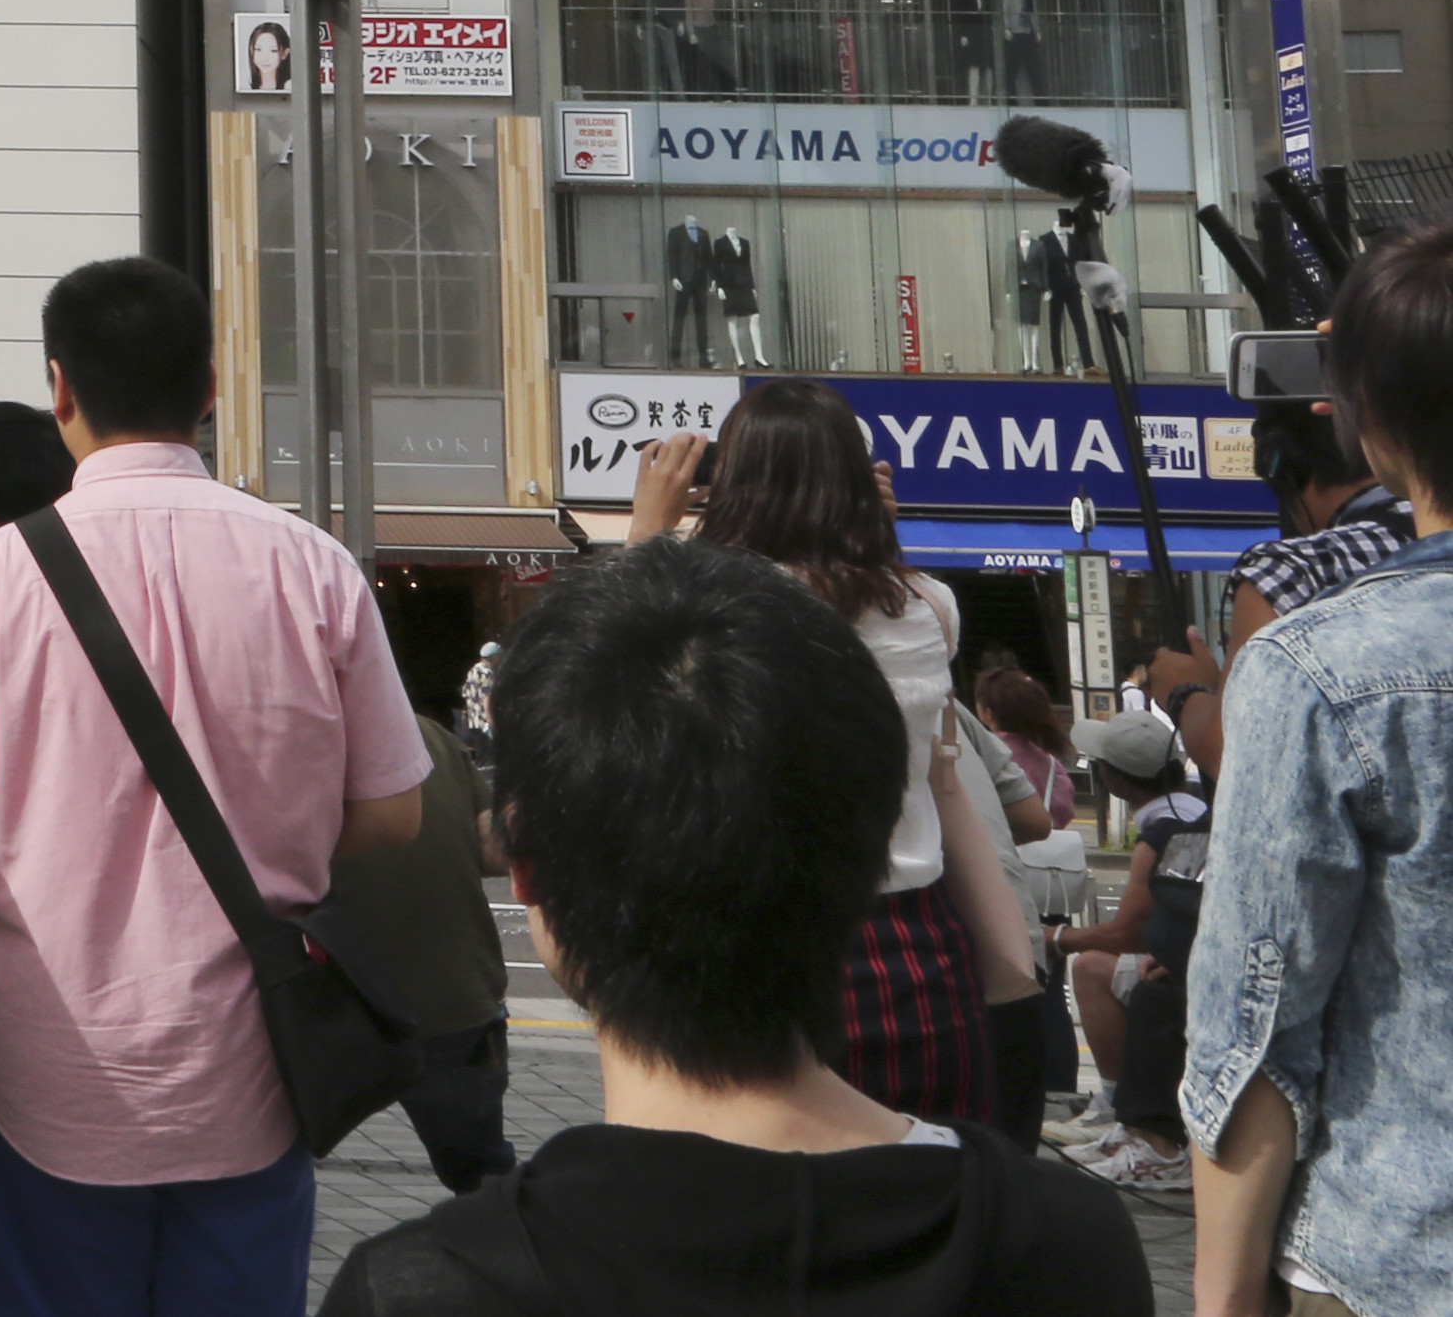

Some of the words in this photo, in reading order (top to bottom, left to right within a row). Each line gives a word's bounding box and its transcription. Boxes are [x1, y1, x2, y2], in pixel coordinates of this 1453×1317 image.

[362, 22, 418, 45] タジオ
[423, 23, 503, 45] エイメイ
[362, 50, 504, 64] ーディション写真・ヘアメイク
[837, 23, 852, 91] SALE
[370, 67, 397, 84] 2F
[649, 128, 861, 161] AOYAMA
[898, 280, 914, 353] SALE
[648, 400, 714, 429] 喫茶室
[1141, 423, 1193, 439] 洋服の
[401, 436, 490, 455] AOKI
[856, 415, 1124, 473] YAMA
[1143, 444, 1195, 471] 青山
[486, 553, 557, 566] AOKI
[984, 554, 1052, 567] AOYAMA
